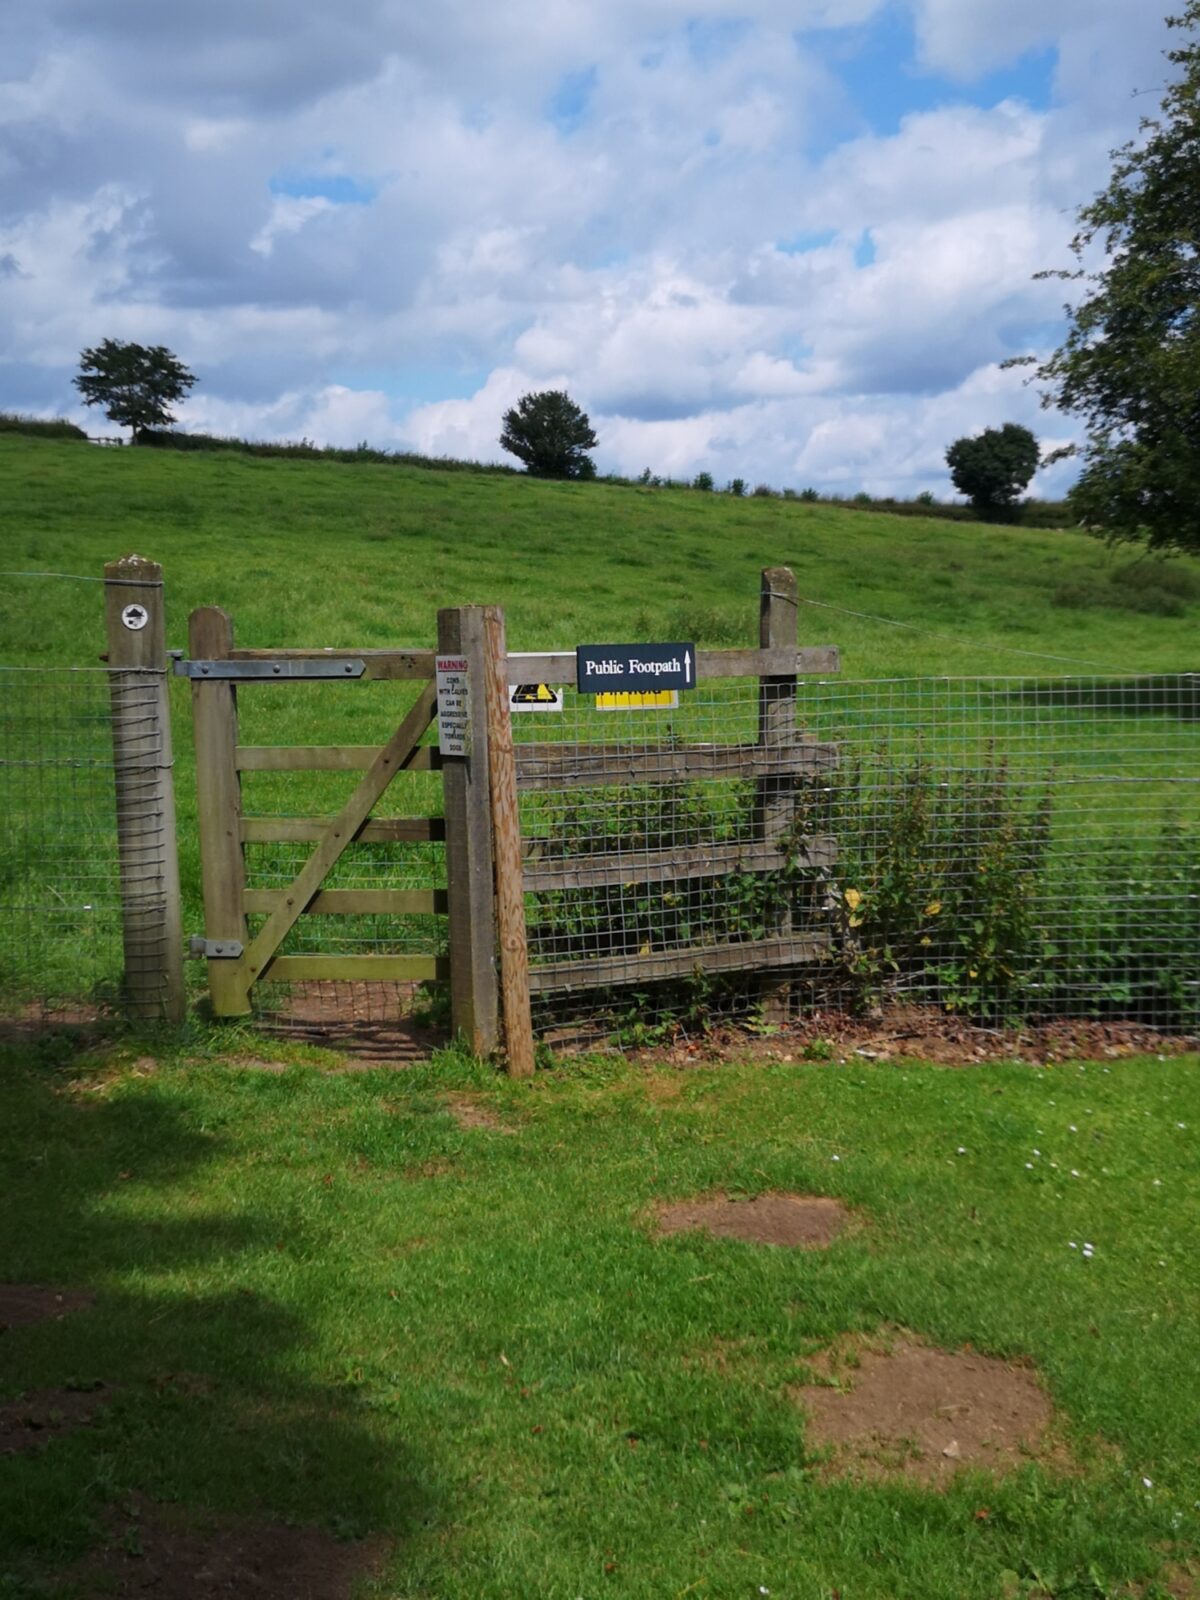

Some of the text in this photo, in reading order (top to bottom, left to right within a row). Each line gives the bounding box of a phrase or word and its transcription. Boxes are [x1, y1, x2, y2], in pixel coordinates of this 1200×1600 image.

[437, 660, 468, 670] WARNING
[586, 658, 681, 676] Public Footpath
